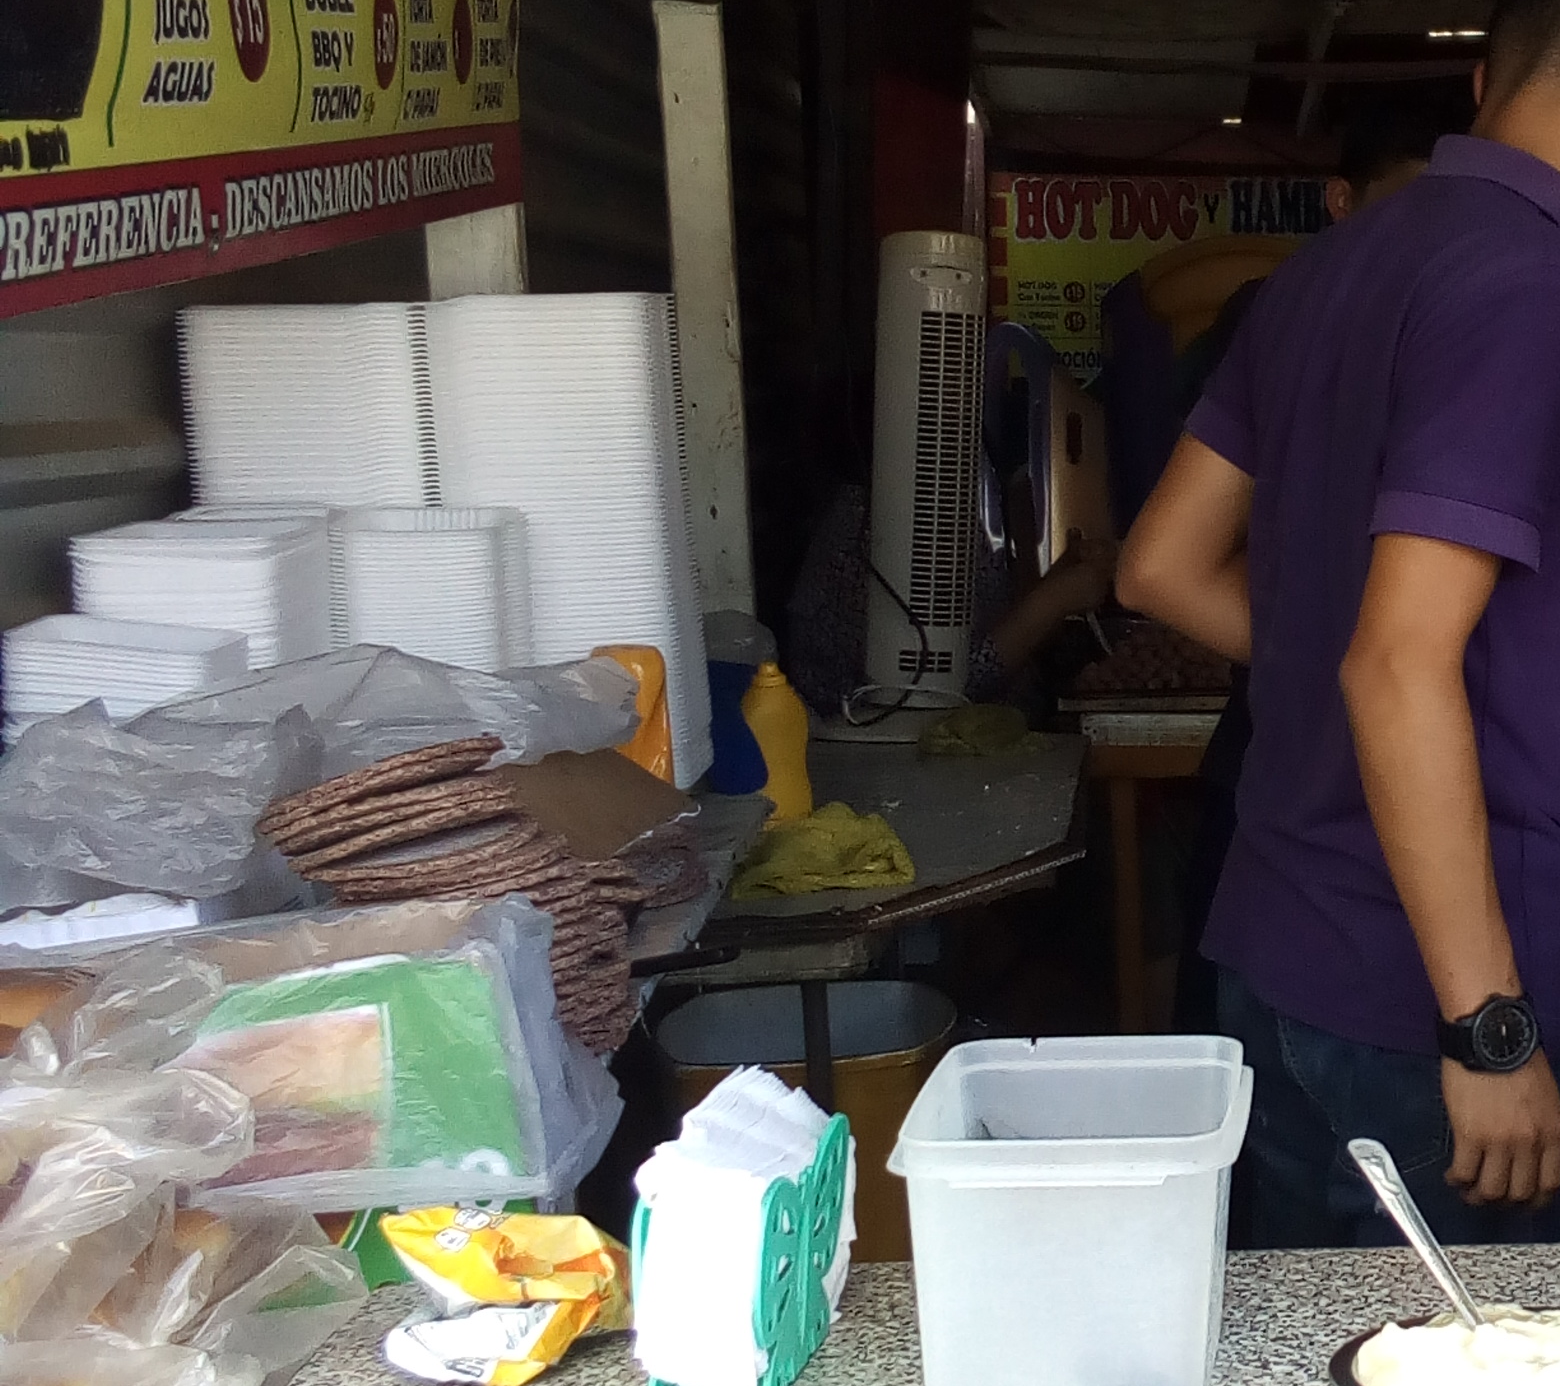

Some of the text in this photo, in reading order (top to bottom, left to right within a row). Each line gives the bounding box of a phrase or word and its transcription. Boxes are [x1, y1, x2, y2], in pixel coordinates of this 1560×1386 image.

[312, 30, 354, 73] BBQ Y
[143, 61, 215, 104] AGUAS
[311, 85, 362, 124] TOCINO
[224, 161, 373, 239] DESCANSAMOS
[377, 155, 409, 206] LOS
[412, 142, 495, 197] MIERCOLES
[1012, 177, 1101, 241] HOT
[1109, 179, 1199, 241] DOG
[1204, 193, 1220, 224] Y
